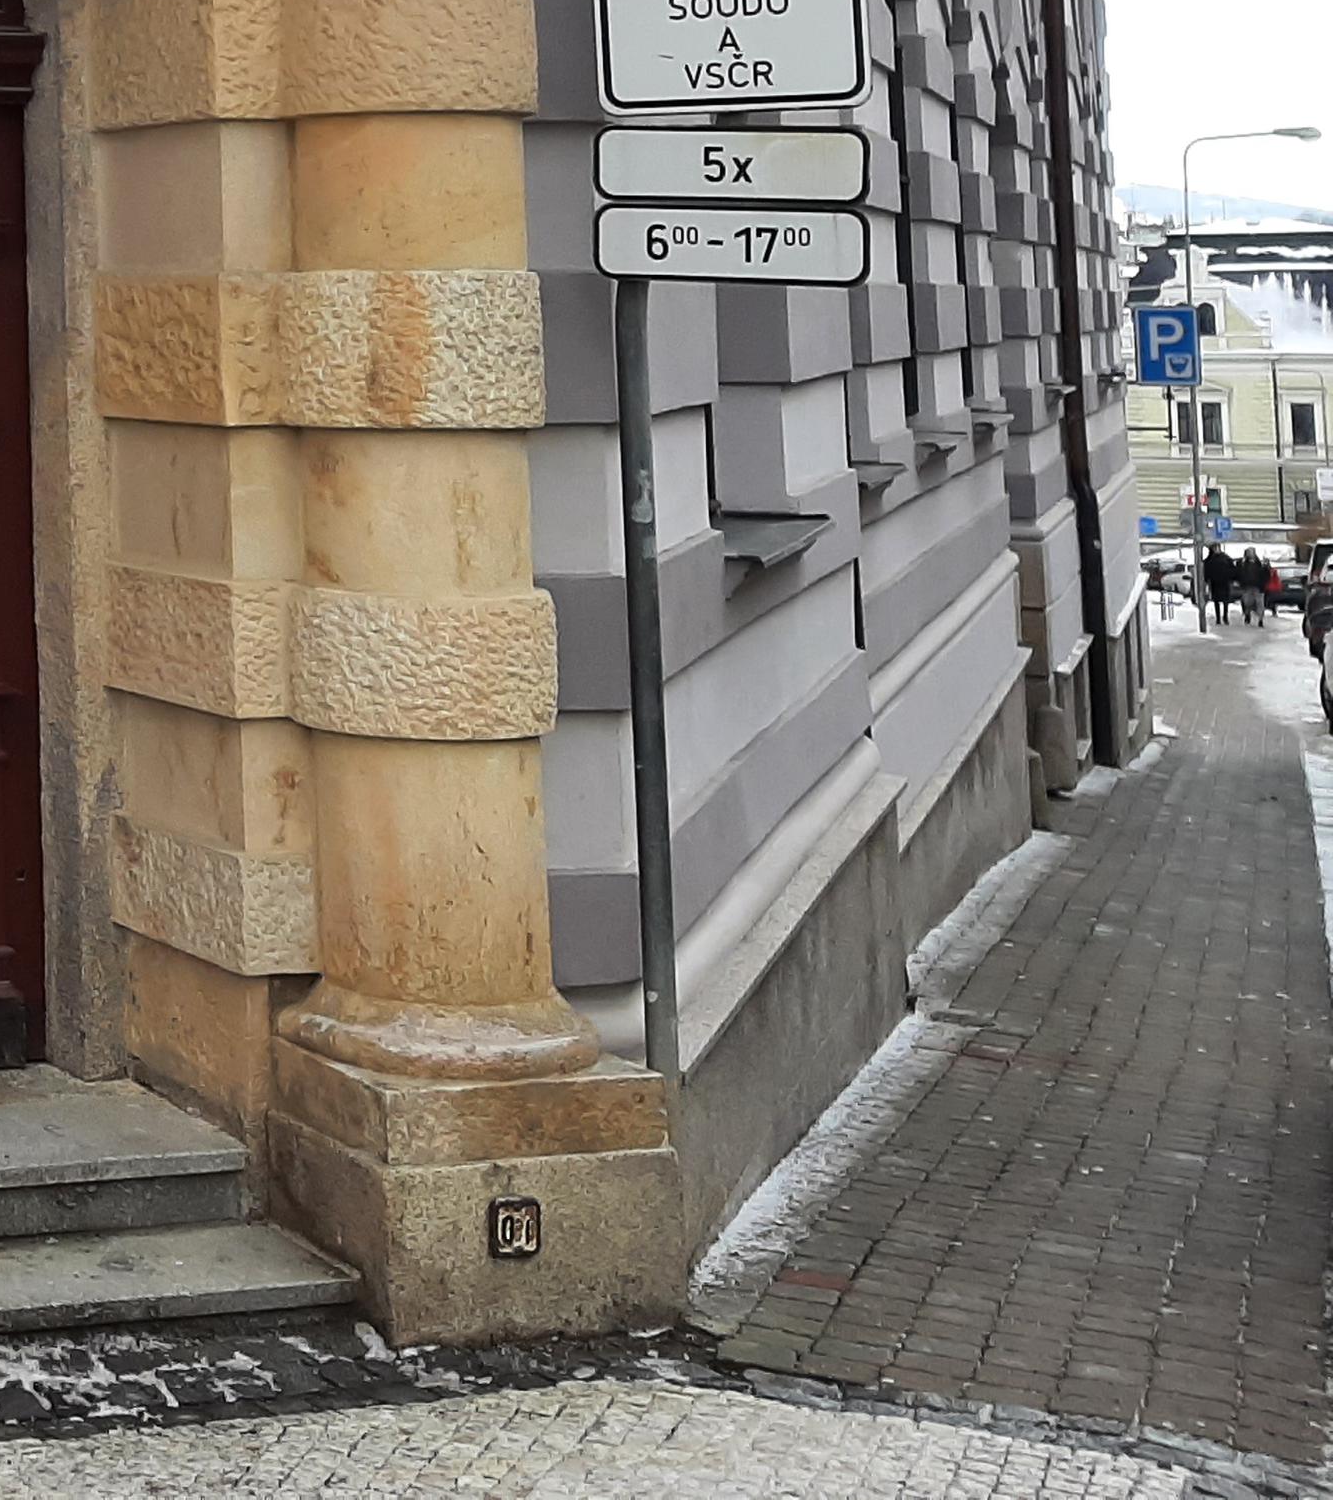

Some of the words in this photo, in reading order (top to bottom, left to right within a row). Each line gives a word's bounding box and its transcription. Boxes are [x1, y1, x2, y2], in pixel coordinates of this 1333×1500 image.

[718, 26, 741, 53] A
[683, 54, 774, 89] VSČR
[702, 145, 754, 184] 5x
[1149, 316, 1183, 360] P
